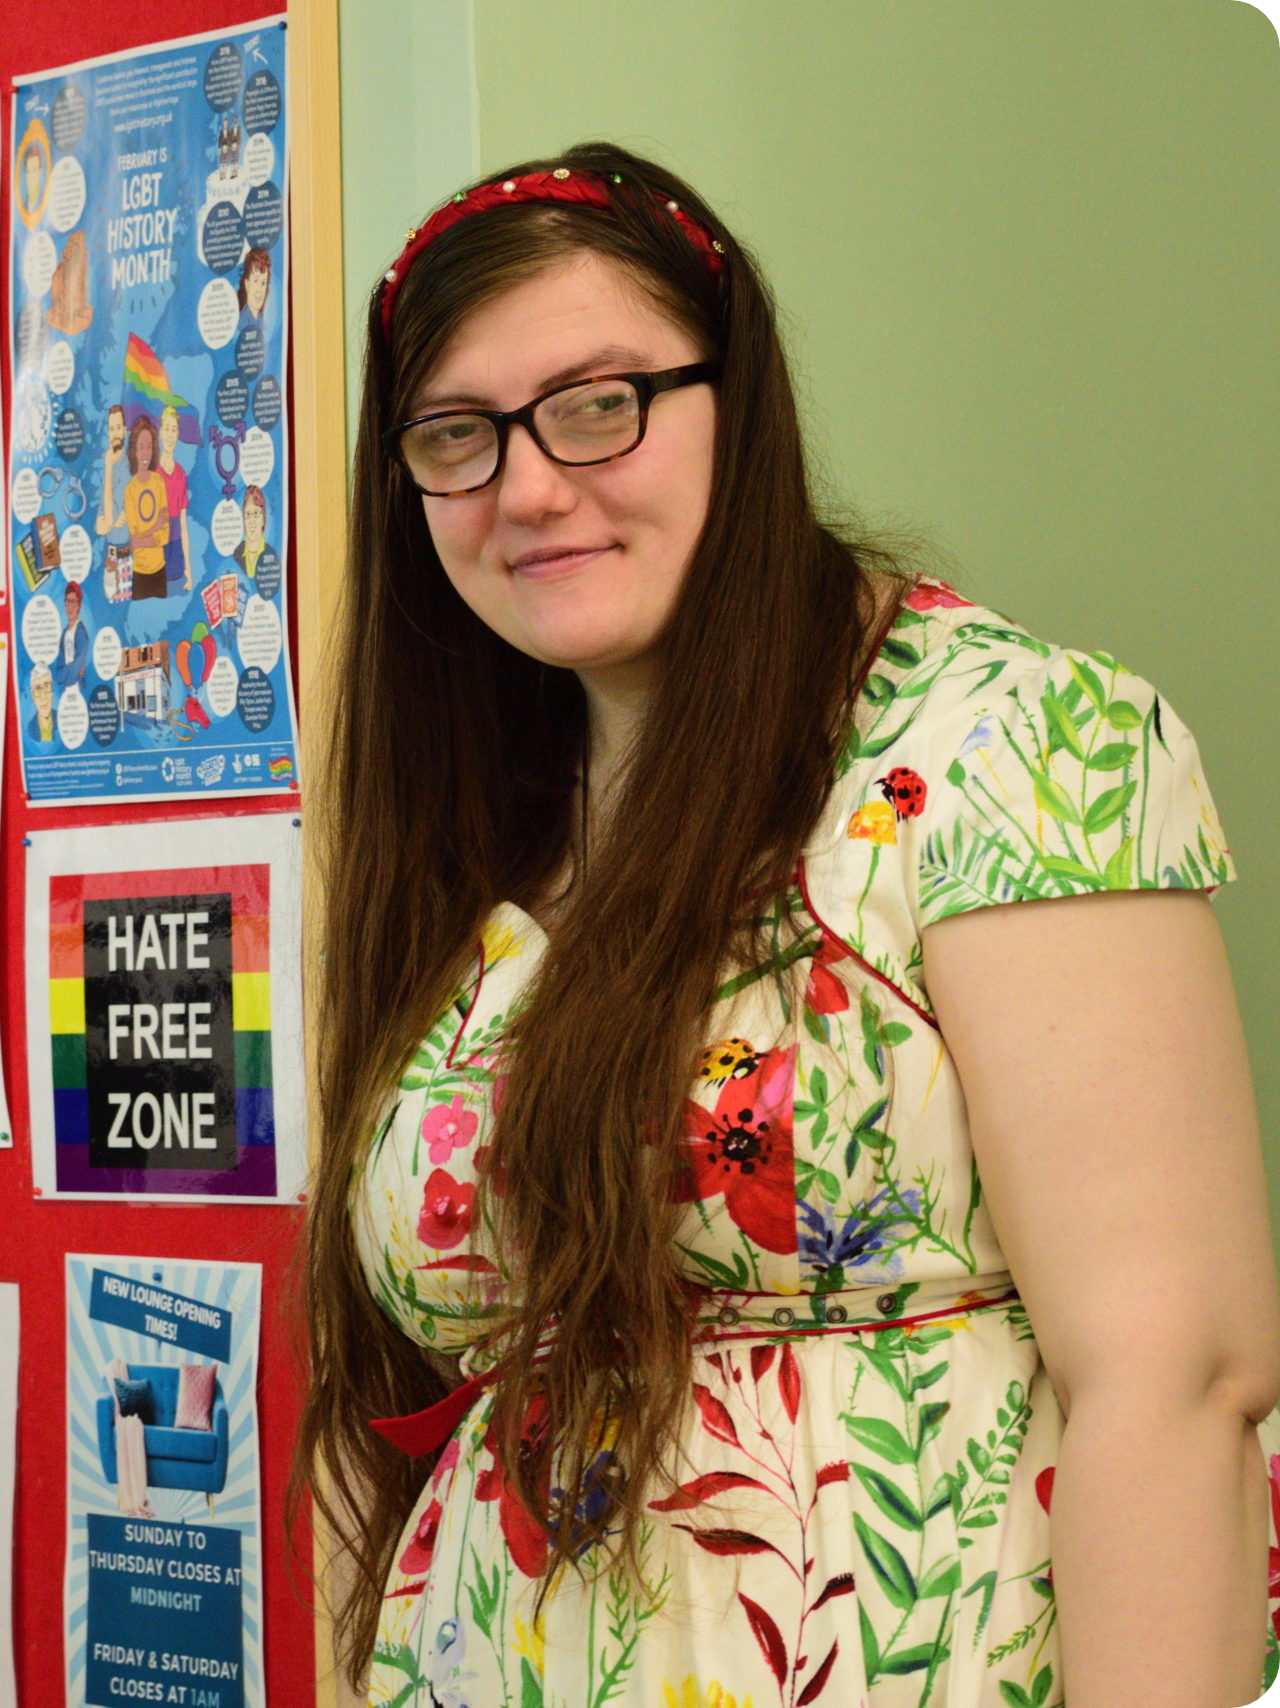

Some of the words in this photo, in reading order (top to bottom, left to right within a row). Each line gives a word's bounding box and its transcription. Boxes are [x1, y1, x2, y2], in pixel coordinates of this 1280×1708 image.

[117, 149, 157, 171] FEBRUARY
[159, 147, 167, 163] IS
[122, 172, 162, 211] LGBT
[108, 208, 177, 254] HISTORY
[111, 248, 172, 290] MONTH
[108, 912, 210, 971] HATE
[108, 1003, 212, 1060] FREE
[107, 1092, 216, 1149] ZONE
[103, 1276, 130, 1299] NEW
[130, 1283, 174, 1313] LOUNGE
[174, 1299, 221, 1329] OPENING
[145, 1314, 178, 1341] TIMES!
[124, 1524, 183, 1548] SUNDAY
[187, 1531, 206, 1550] TO
[89, 1550, 164, 1576] THURSDAY
[168, 1560, 222, 1584] CLOSES
[225, 1568, 242, 1587] AT
[130, 1586, 202, 1613] MIDNIGHT
[93, 1643, 145, 1667] FRIDAY
[148, 1651, 158, 1669] &
[161, 1653, 239, 1681] SATURDAY
[110, 1677, 164, 1701] CLOSES
[167, 1686, 188, 1705] AT
[191, 1688, 220, 1708] 1AM
